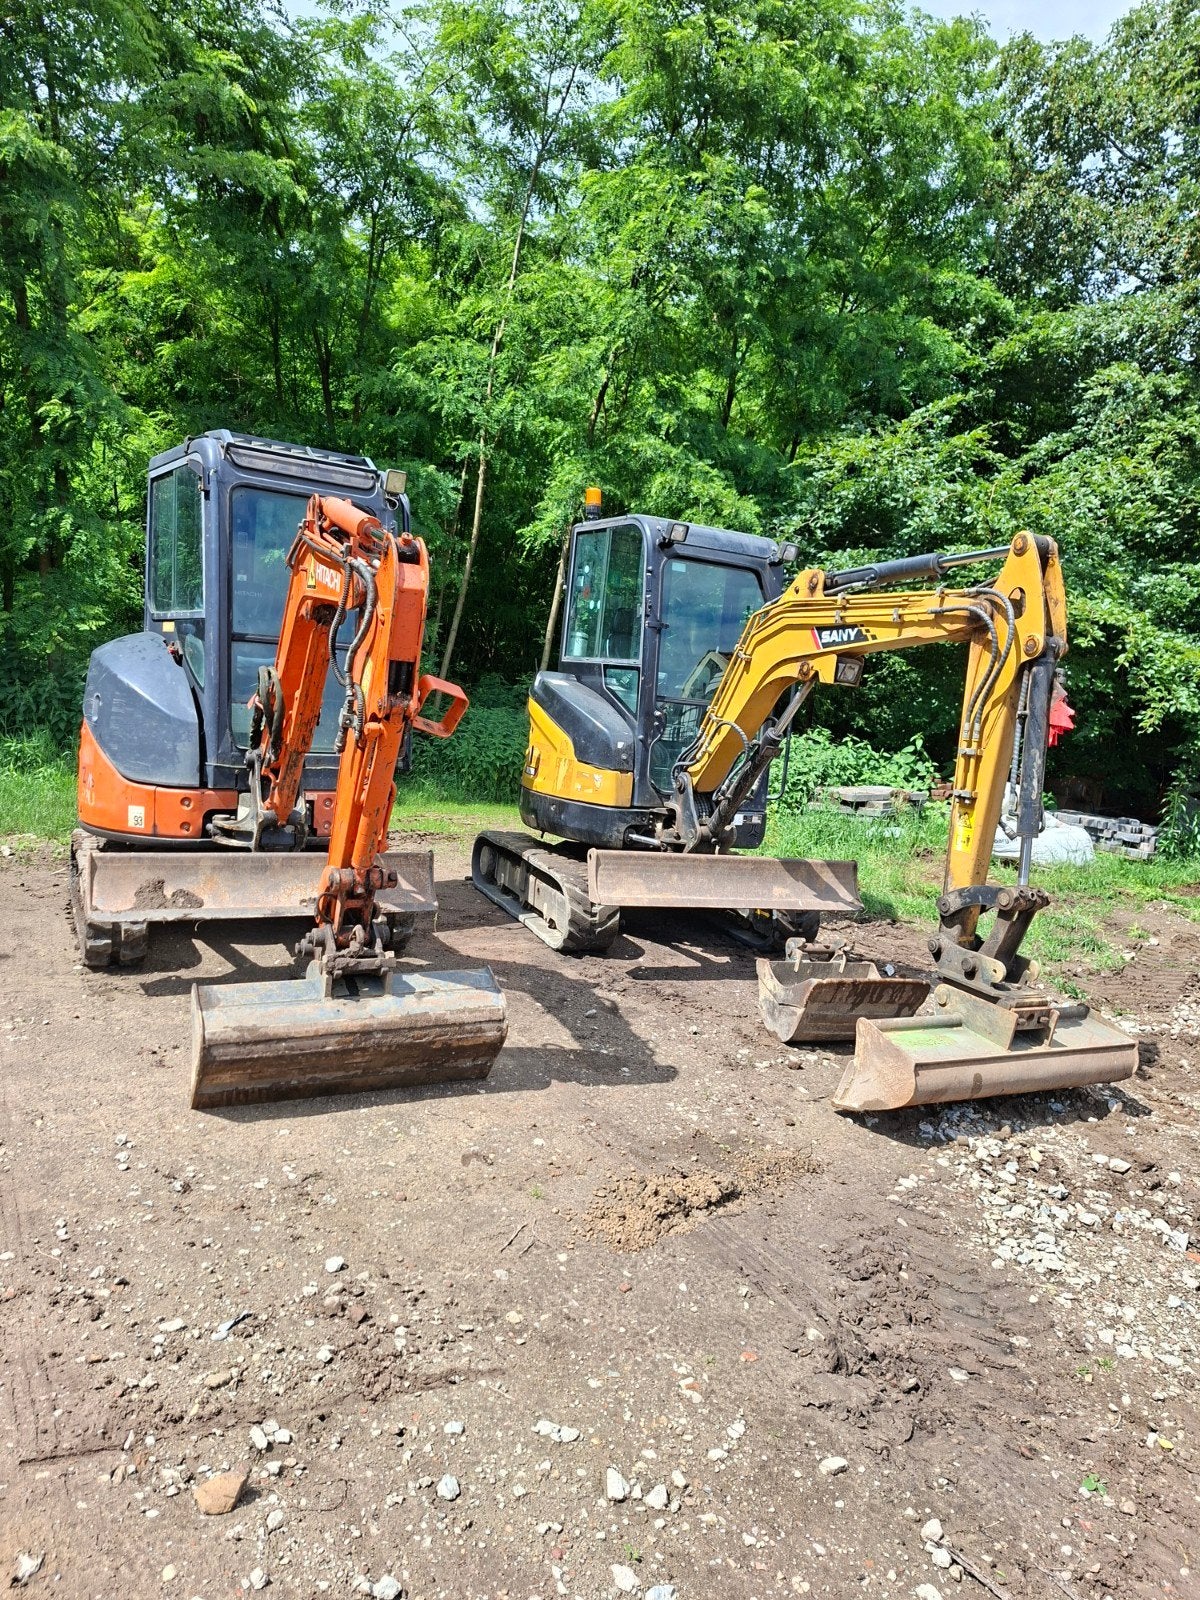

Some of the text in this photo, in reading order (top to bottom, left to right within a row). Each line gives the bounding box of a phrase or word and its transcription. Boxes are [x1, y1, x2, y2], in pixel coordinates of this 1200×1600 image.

[315, 561, 341, 593] HITACHI
[234, 590, 263, 598] HITACHI
[821, 627, 859, 644] SANY
[133, 815, 143, 826] 93
